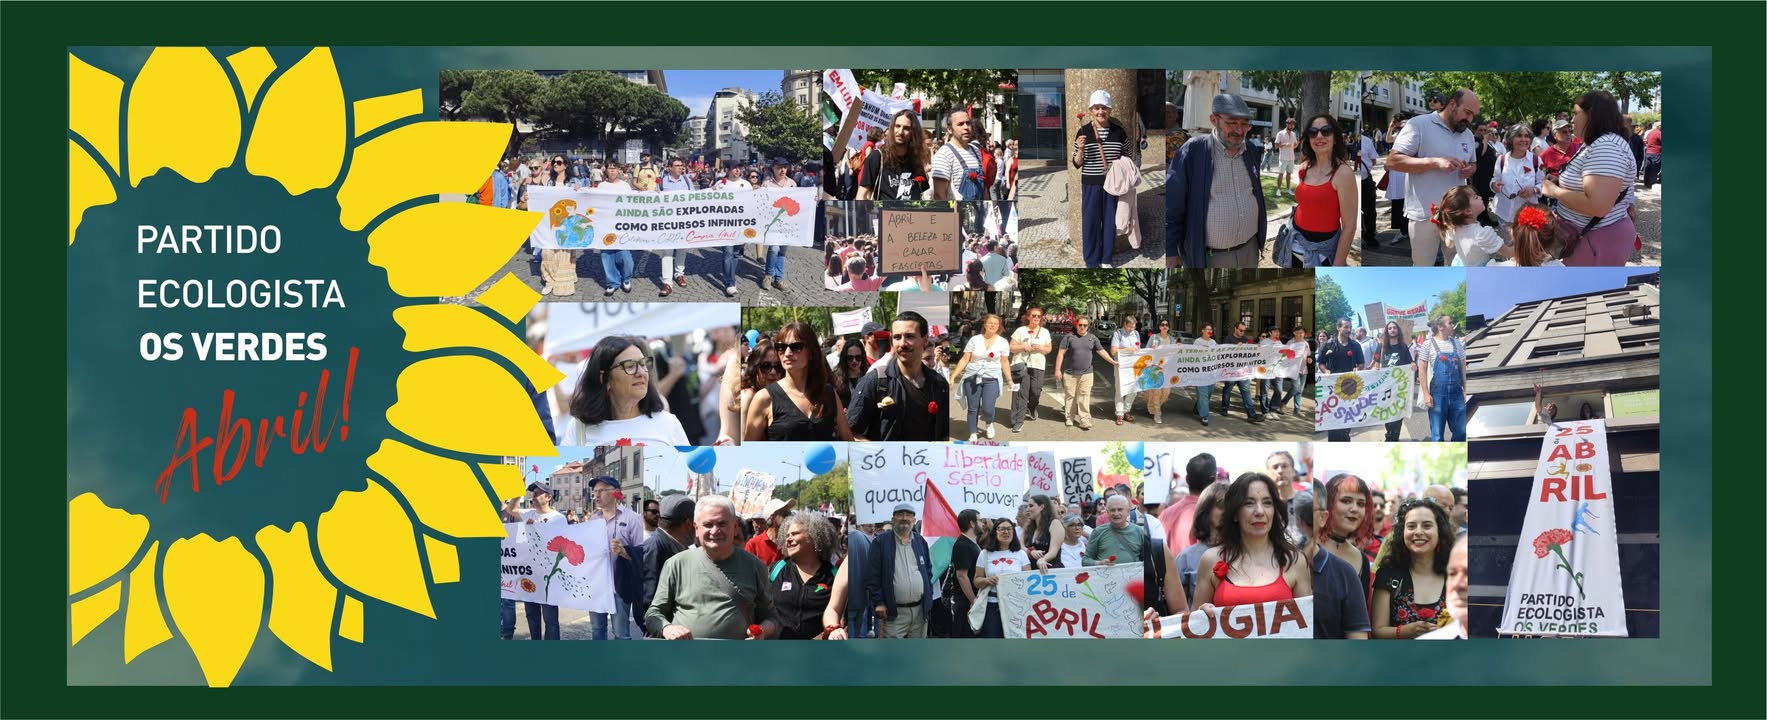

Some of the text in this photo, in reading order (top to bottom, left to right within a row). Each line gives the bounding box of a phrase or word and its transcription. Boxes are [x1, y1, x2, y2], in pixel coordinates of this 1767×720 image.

[829, 70, 843, 88] EM
[627, 195, 659, 204] TERRA
[663, 194, 669, 203] E
[672, 194, 685, 202] AS
[688, 192, 734, 202] PESSOAS
[615, 205, 744, 217] AINDA SÃO EXPLORADAS
[615, 218, 756, 231] COMO RECURSOS INFINITOS
[930, 214, 937, 224] E
[887, 231, 953, 243] A BELEZA DE
[902, 246, 937, 257] CALAR
[1202, 354, 1216, 363] SÃO
[1202, 361, 1235, 372] RECURSOS
[1333, 393, 1378, 424] SAÚDE
[1555, 426, 1594, 437] 25
[861, 445, 1024, 473] só há Liberdade
[1547, 442, 1596, 462] AB
[1062, 458, 1087, 475] DE
[947, 470, 1002, 487] sério
[1065, 472, 1092, 486] MO
[1540, 475, 1607, 502] RIL
[865, 485, 1019, 514] quand houver
[501, 564, 533, 575] NITOS
[1026, 574, 1077, 599] 25 de
[1520, 593, 1575, 607] PARTIDO
[1025, 599, 1106, 638] ABRIL
[1516, 606, 1605, 621] ECOLOGISTA
[1514, 621, 1533, 632] OS
